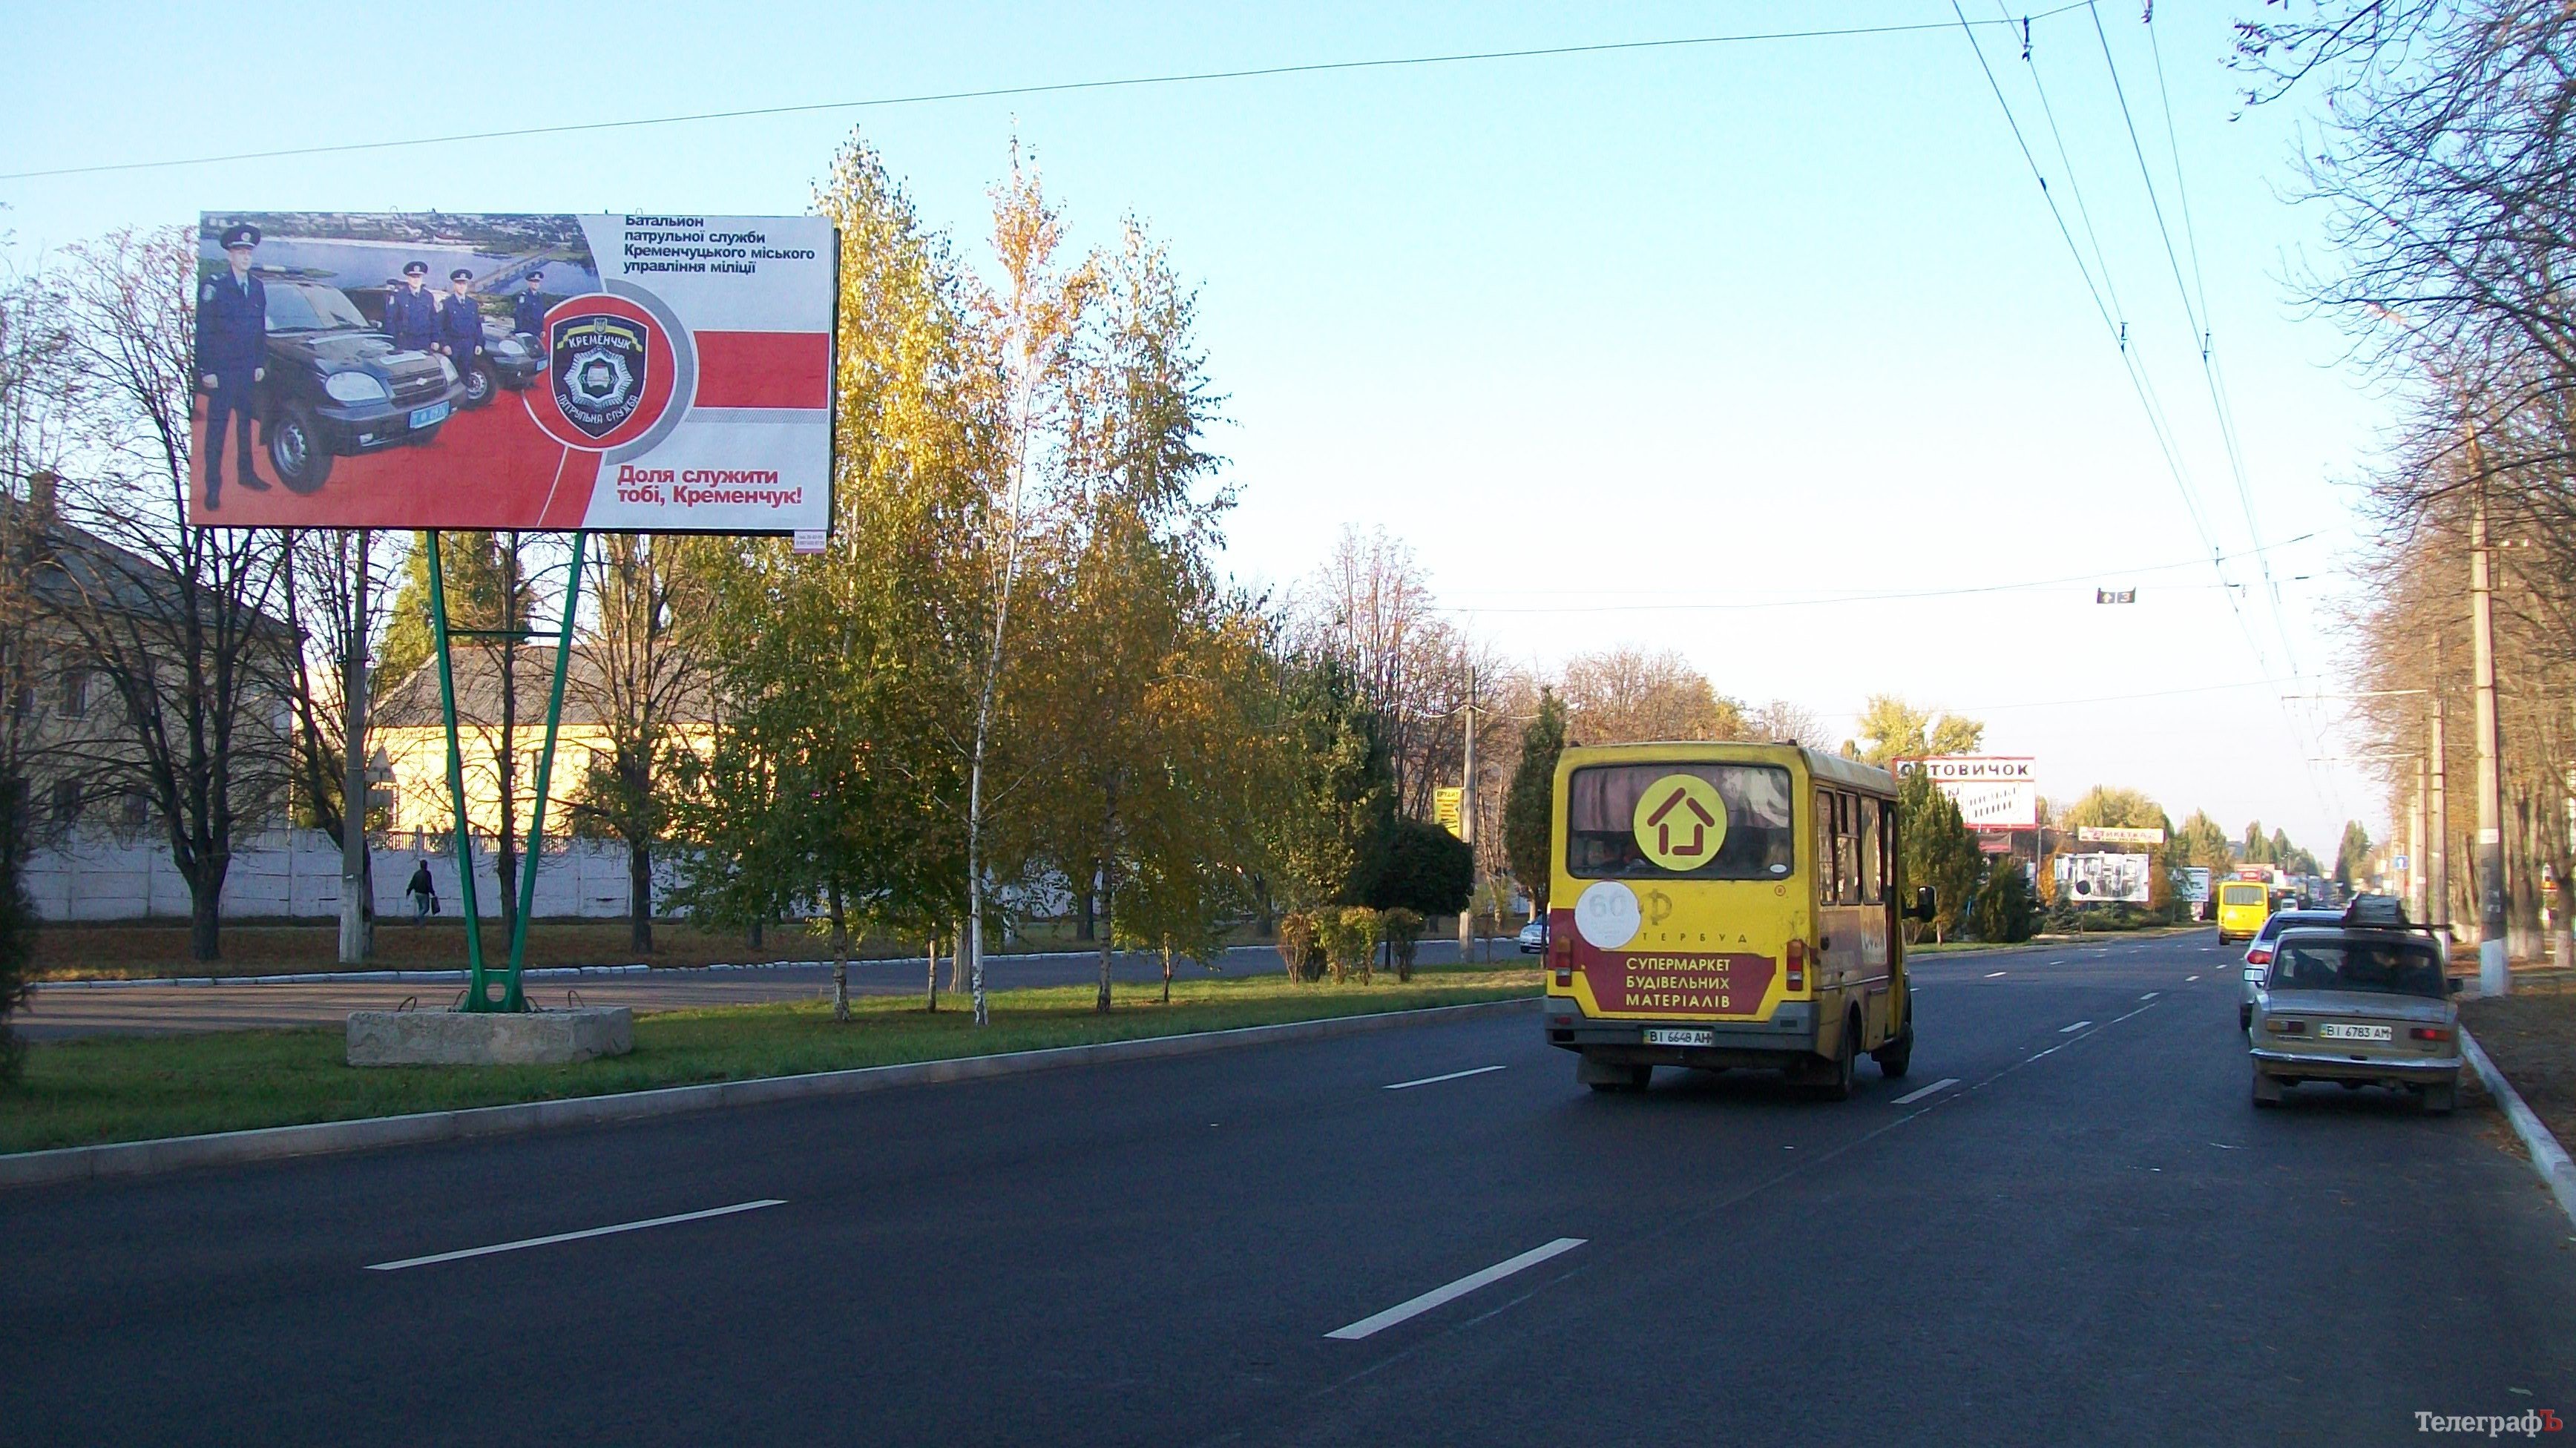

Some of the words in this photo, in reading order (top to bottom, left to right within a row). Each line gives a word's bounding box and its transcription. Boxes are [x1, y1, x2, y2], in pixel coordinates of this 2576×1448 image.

[625, 214, 704, 227] Батальион
[625, 230, 706, 244] патрульної
[709, 231, 765, 246] служби
[625, 243, 746, 260] Кременчуцького
[751, 246, 815, 260] міського
[623, 260, 706, 274] управління
[711, 260, 756, 275] міліції
[568, 335, 631, 350] КРЕМЕНЧУК
[556, 393, 604, 424] ПАТРУЛЬНА
[606, 395, 639, 421] СЛУЖБА
[617, 465, 674, 485] Доля
[682, 470, 778, 487] служити
[617, 485, 666, 506] тобі,
[673, 485, 803, 508] Кременчук!
[1899, 763, 2029, 777] ОТОВИЧОК
[1626, 958, 1731, 971] СУПЕРМАРКЕТ
[1626, 975, 1730, 990] БУДІВЕЛЬНИХ
[1626, 994, 1730, 1007] МАТЕРІАЛІВ
[2346, 1027, 2370, 1038] 6783
